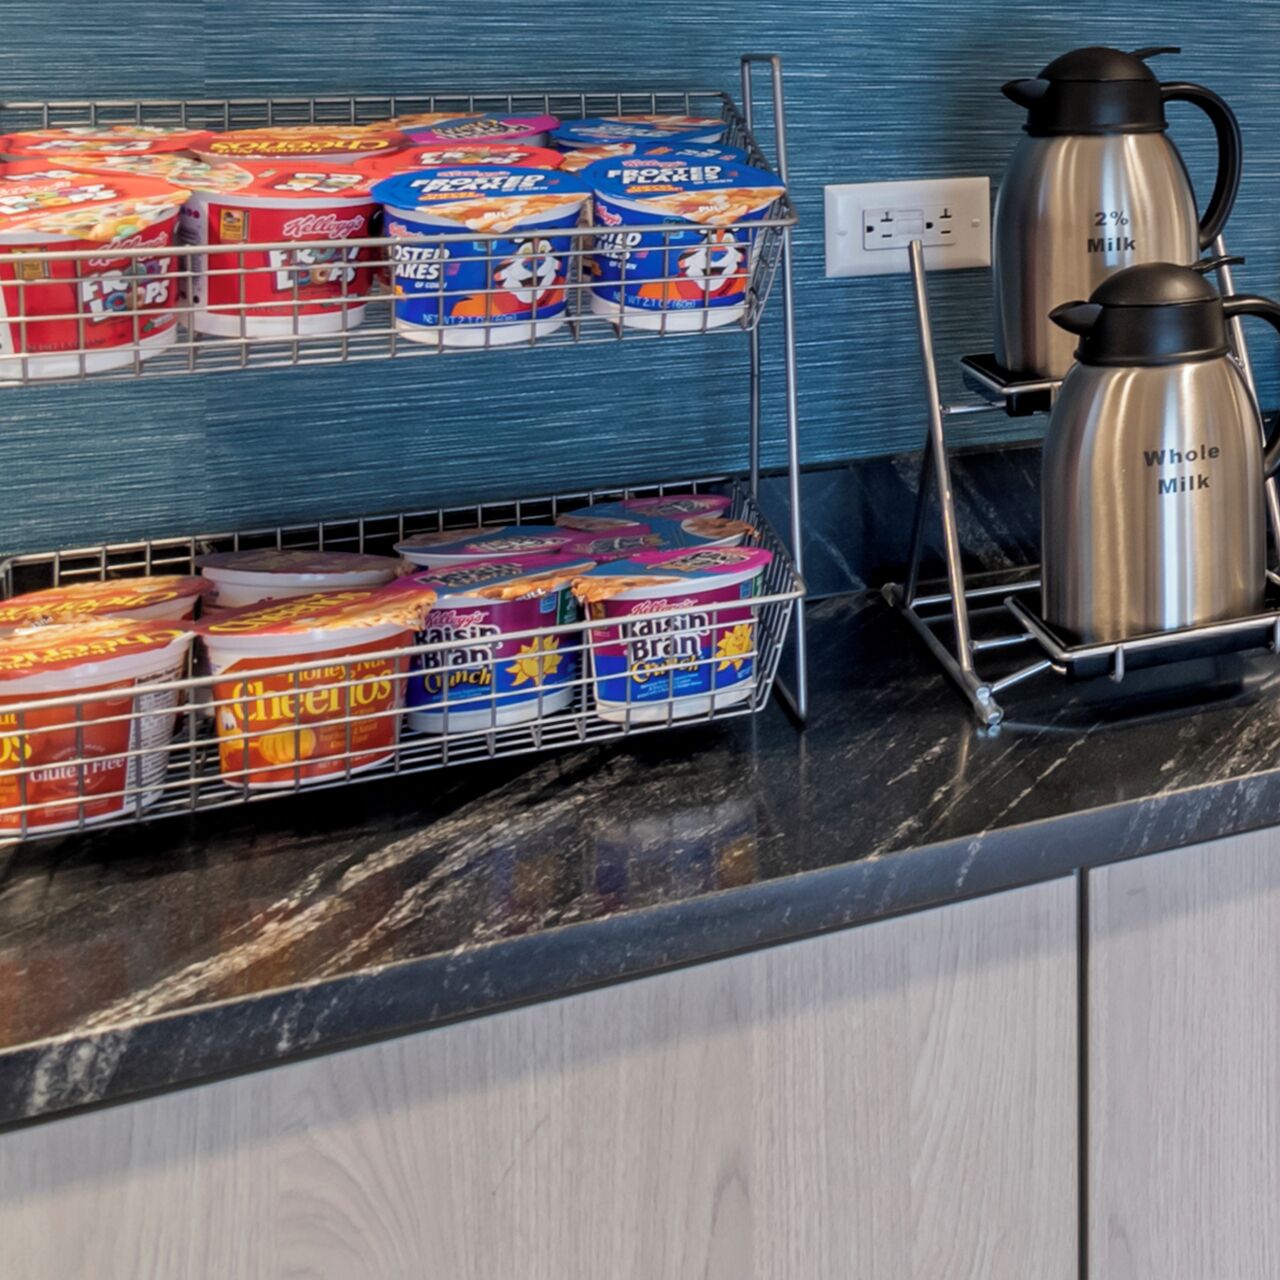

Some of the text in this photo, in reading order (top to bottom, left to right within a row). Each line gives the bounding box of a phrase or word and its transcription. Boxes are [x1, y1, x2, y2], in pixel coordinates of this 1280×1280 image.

[283, 214, 365, 239] Kellogg's
[1094, 210, 1129, 226] 2%
[1087, 236, 1136, 253] Milk
[1143, 444, 1220, 468] Whole
[1158, 474, 1210, 495] Milk
[632, 634, 699, 661] Bran
